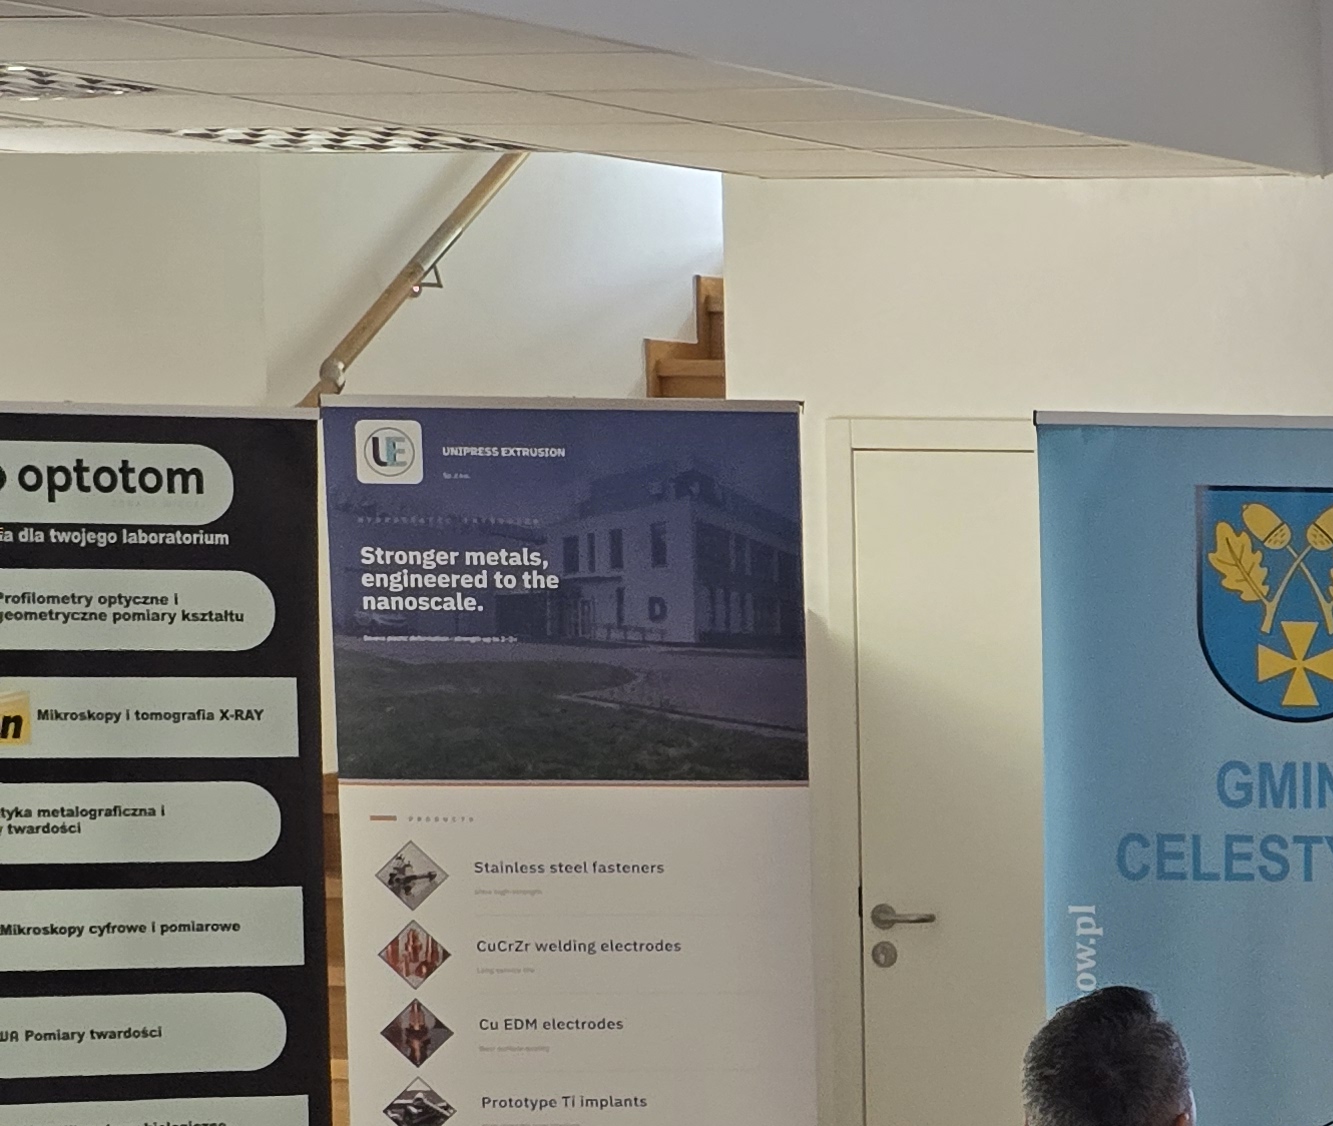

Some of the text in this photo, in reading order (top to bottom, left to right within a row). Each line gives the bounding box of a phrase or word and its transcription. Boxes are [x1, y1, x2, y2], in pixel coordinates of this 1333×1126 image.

[442, 446, 566, 458] UNIPRESS EXTRUSION
[18, 458, 205, 503] optotom
[18, 527, 45, 543] dla
[50, 528, 117, 547] twojego
[123, 529, 230, 545] laboratorium
[361, 547, 549, 570] Stronger metals,
[361, 569, 560, 592] engineered to the
[98, 593, 169, 608] optyczne
[362, 592, 484, 612] nanoscale.
[112, 609, 176, 625] pomiary
[181, 609, 244, 623] kształtu
[37, 708, 265, 724] Mikroskopy i tomografia X-RAY
[0, 806, 32, 821] tyka
[37, 805, 156, 821] metalograficzna
[7, 822, 81, 835] twardości
[474, 861, 665, 874] Stainless steel fasteners
[0, 923, 84, 938] Mikroskopy
[89, 922, 147, 937] cyfrowe
[160, 921, 241, 935] pomiarowe
[476, 939, 682, 955] CuCrZr welding electrodes
[1067, 905, 1103, 992] ow.pl
[479, 1018, 624, 1030] Cu EDM electrodes
[25, 1026, 162, 1044] Pomiary twardości
[481, 1095, 648, 1111] Prototype Ti implants
